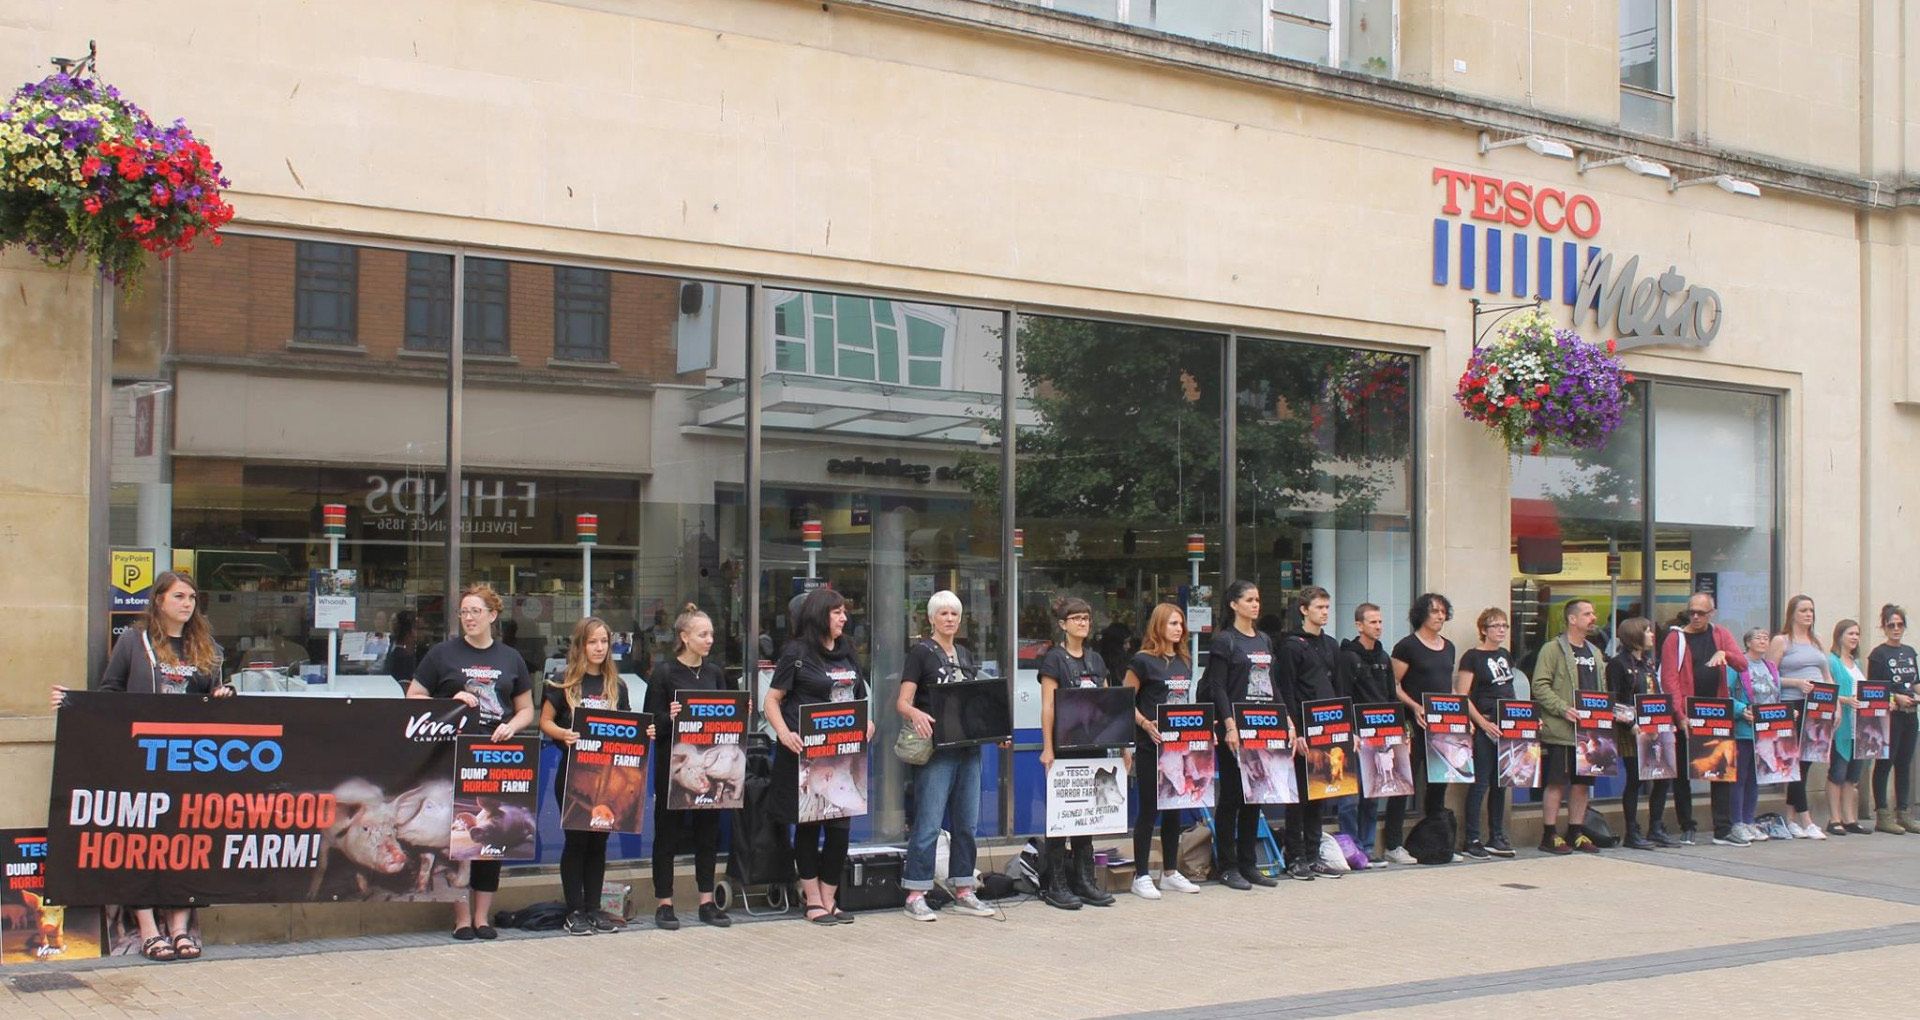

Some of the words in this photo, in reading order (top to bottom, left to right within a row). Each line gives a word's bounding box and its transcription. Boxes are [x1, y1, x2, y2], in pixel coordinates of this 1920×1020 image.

[1433, 167, 1601, 239] TESCO
[1573, 252, 1721, 347] Metro
[114, 554, 150, 563] PayPoint
[114, 596, 124, 605] in
[125, 596, 150, 605] store
[1431, 701, 1461, 712] TESCO
[1582, 698, 1608, 708] TESCO
[1642, 704, 1666, 714] TESCO
[689, 704, 736, 717] TESCO
[1311, 710, 1343, 723] TESCO
[1506, 707, 1533, 718] TESCO
[1695, 707, 1726, 717] TESCO
[1759, 709, 1786, 720] TESCO
[405, 711, 468, 739] Viva!
[813, 714, 855, 730] TESCO
[1167, 716, 1203, 727] TESCO
[1244, 715, 1278, 726] TESCO
[1364, 714, 1395, 724] TESCO
[588, 721, 637, 739] TESCO
[678, 721, 703, 733] DUMP
[575, 739, 602, 751] DUMP
[714, 733, 740, 745] FARM!
[803, 734, 826, 746] DUMP
[837, 742, 861, 755] FARM!
[138, 739, 283, 772] TESCO
[473, 750, 524, 763] TESCO
[613, 755, 641, 768] FARM!
[461, 768, 488, 780] DUMP
[489, 768, 533, 781] HOGWOOD
[463, 781, 499, 793] HORROR
[501, 781, 529, 793] FARM!
[69, 789, 170, 828] DUMP
[179, 793, 337, 829] HOGWOOD
[78, 832, 212, 870] HORROR
[222, 834, 321, 868] FARM!
[480, 843, 507, 855] Viva!
[6, 863, 37, 876] DUMP
